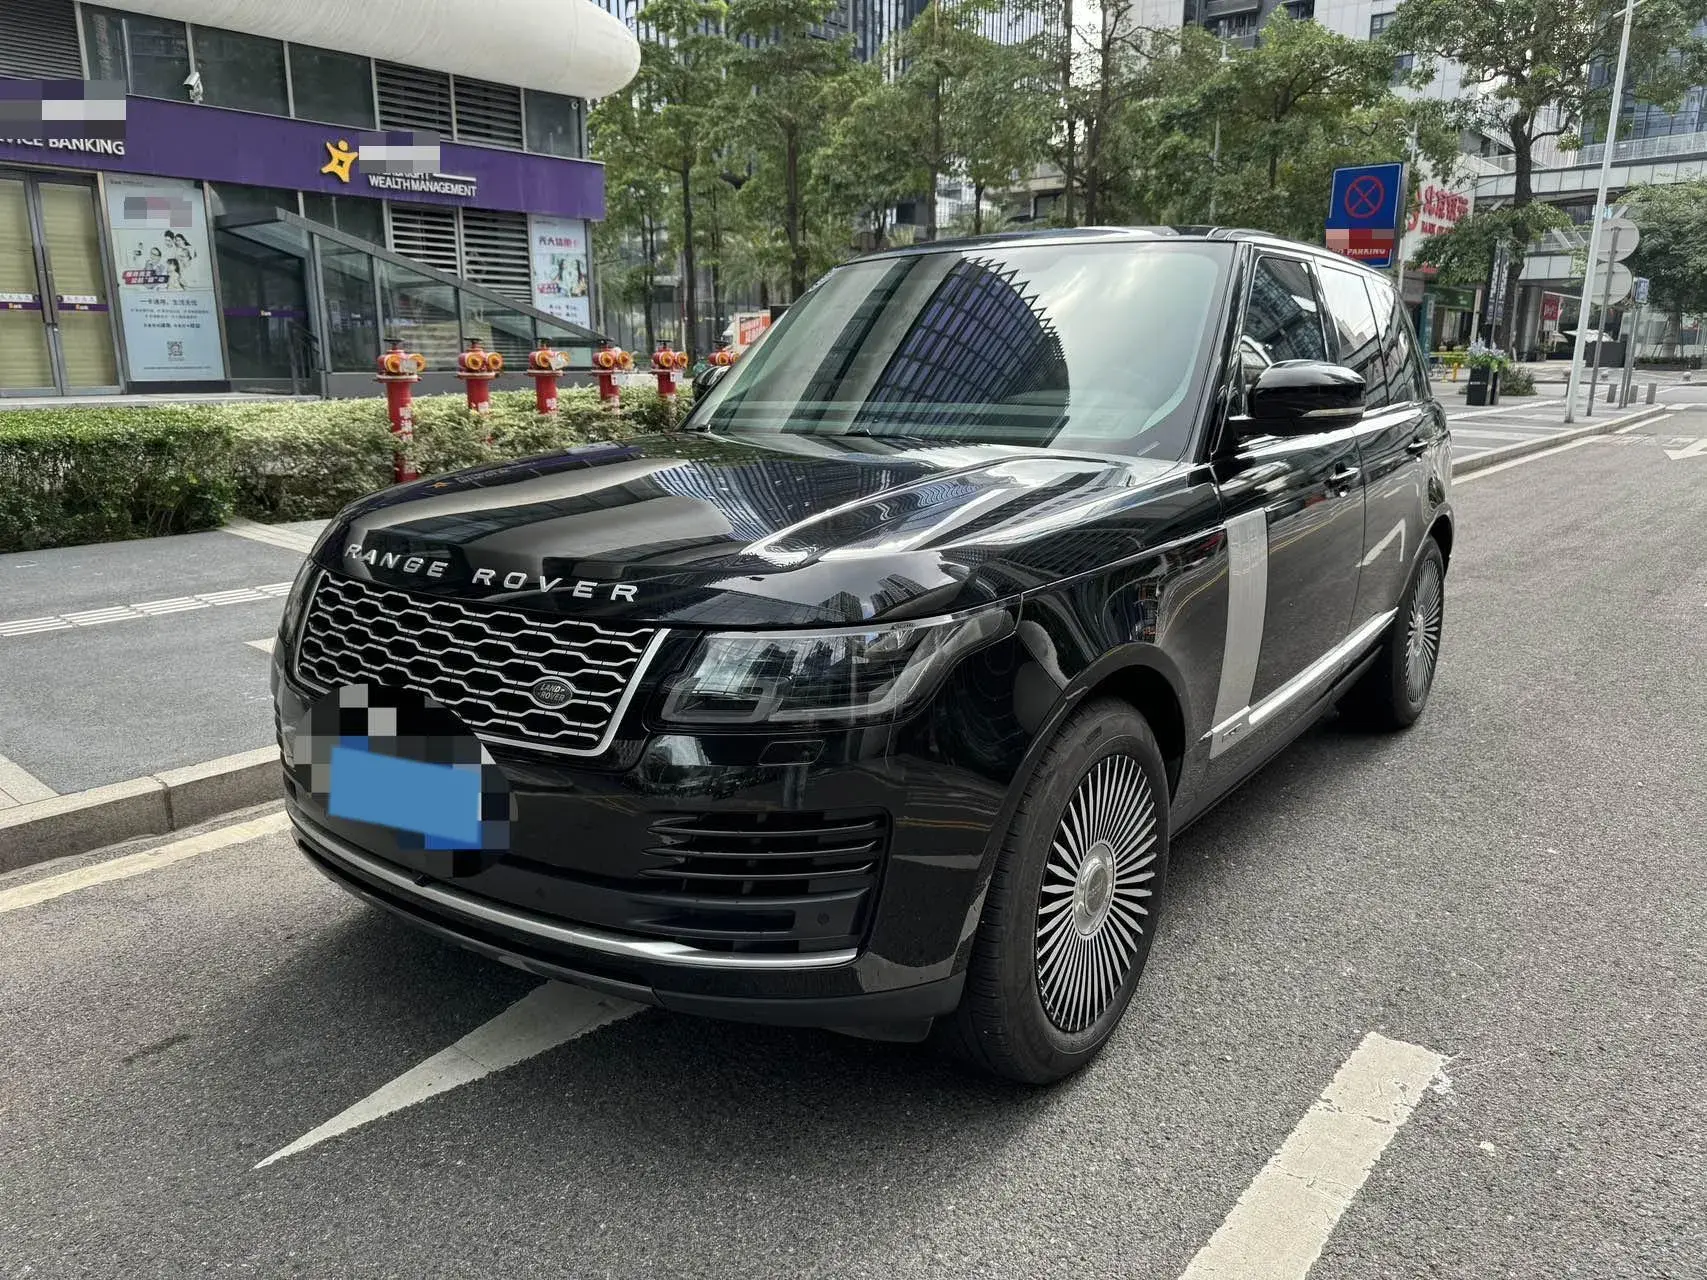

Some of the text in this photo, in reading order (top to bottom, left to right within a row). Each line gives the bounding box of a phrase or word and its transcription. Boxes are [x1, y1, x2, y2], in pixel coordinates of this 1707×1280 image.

[48, 138, 125, 156] BANKING
[368, 174, 411, 190] WEALTH
[411, 180, 477, 197] MANAGEMENT
[344, 543, 638, 603] RANGE ROVER
